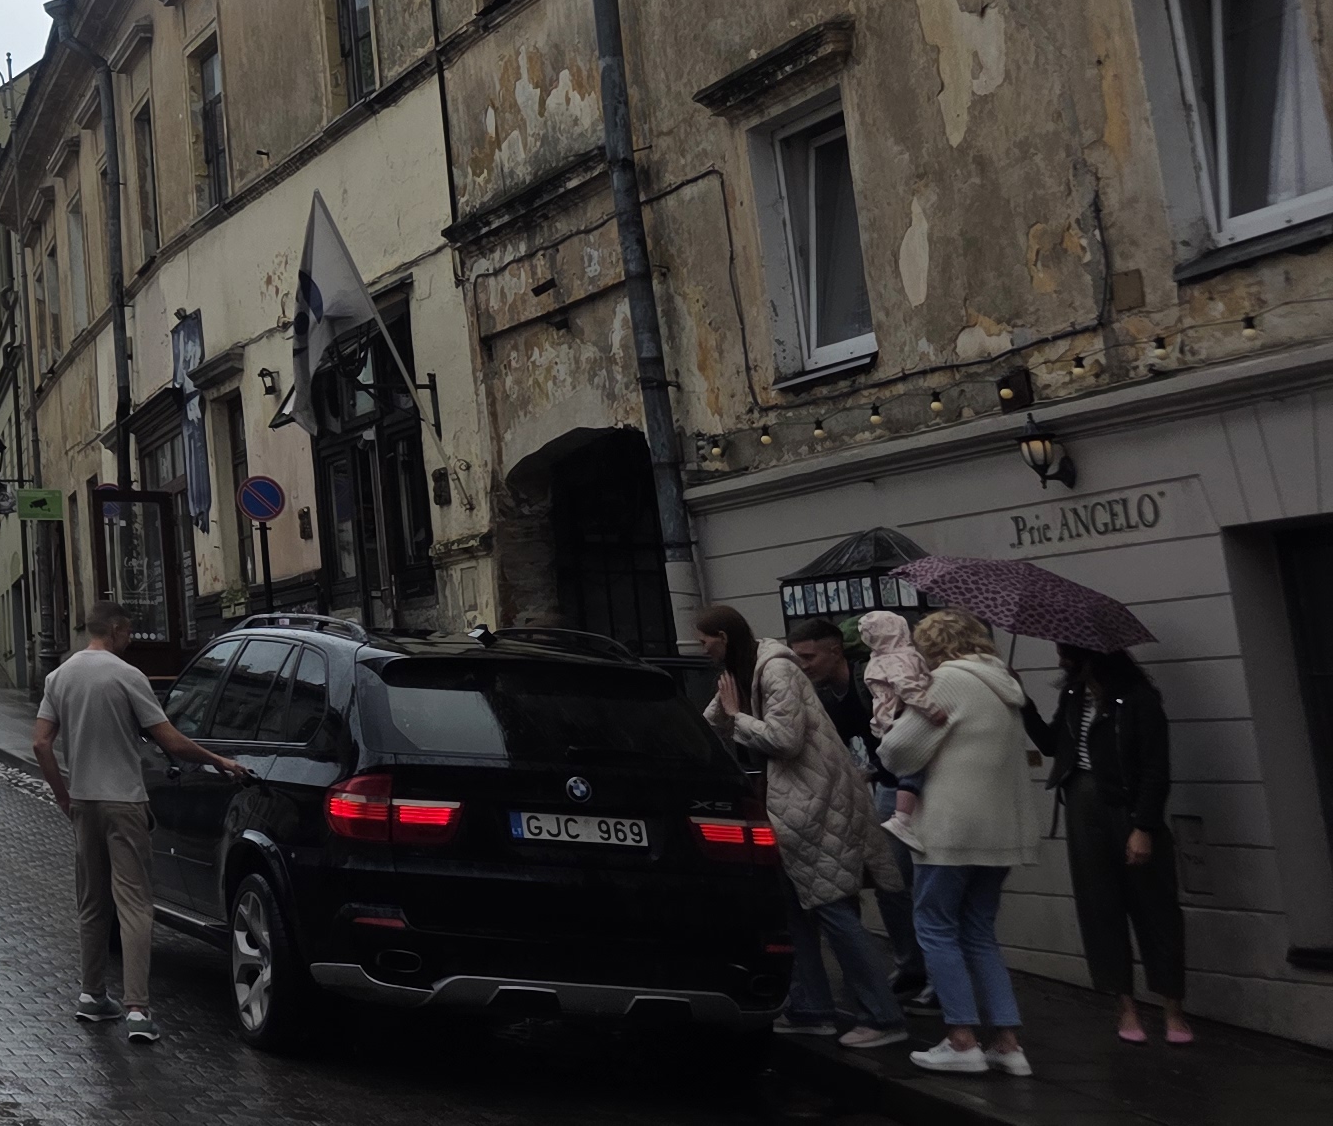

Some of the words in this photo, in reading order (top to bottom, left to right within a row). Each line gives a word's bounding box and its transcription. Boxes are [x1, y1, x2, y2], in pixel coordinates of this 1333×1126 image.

[511, 827, 523, 836] LT
[525, 815, 581, 840] GJC
[597, 819, 644, 844] 969
